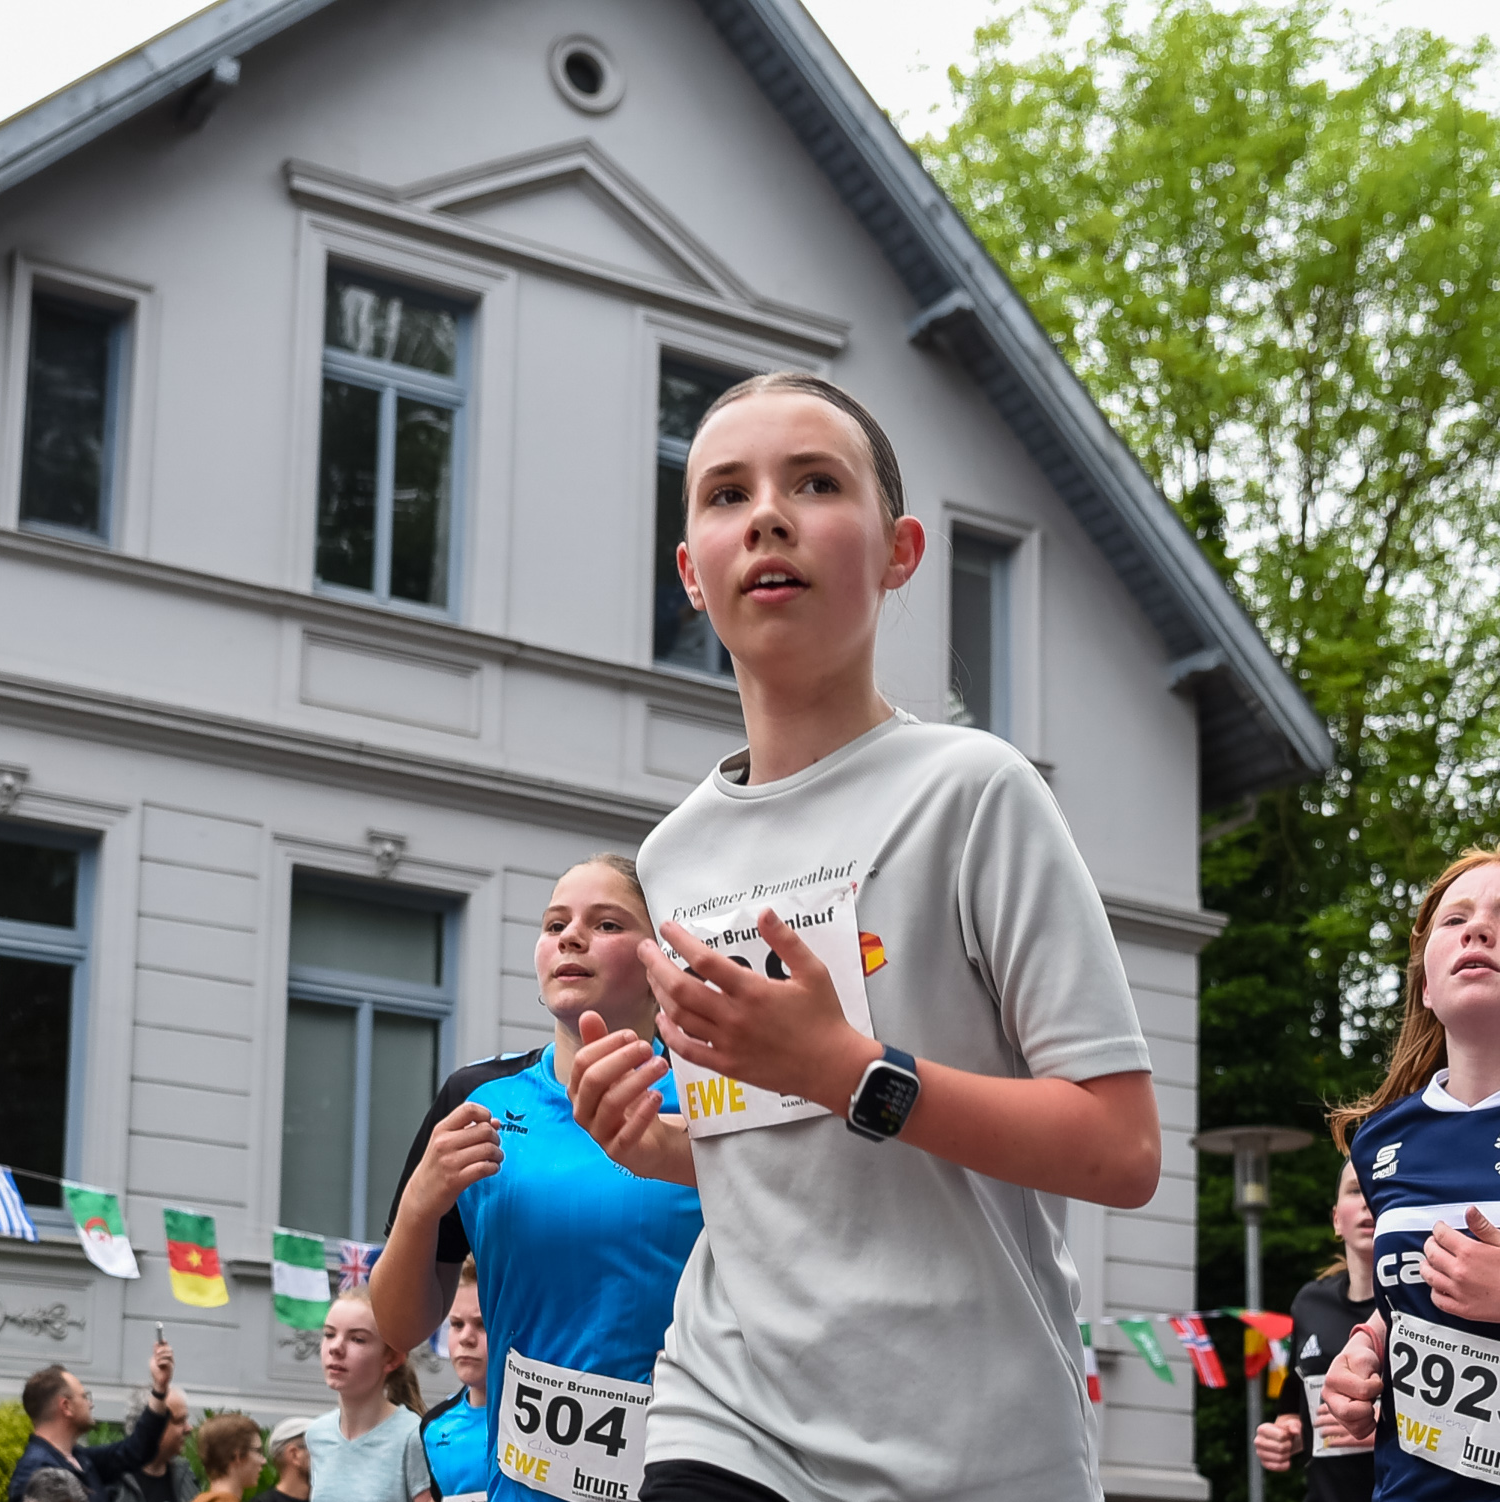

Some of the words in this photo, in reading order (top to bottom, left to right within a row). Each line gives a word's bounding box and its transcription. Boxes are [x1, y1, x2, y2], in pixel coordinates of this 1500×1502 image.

[672, 892, 747, 922] Everstener
[750, 860, 857, 900] Brunnenlauf
[722, 906, 835, 944] Brunnlauf
[685, 1077, 746, 1120] EWE
[1398, 1325, 1458, 1353] Everstener
[508, 1359, 564, 1389] Everstener
[567, 1381, 651, 1406] Brunnenlauf
[514, 1382, 627, 1457] 504
[504, 1443, 551, 1483] EWE
[573, 1467, 629, 1500] bruns
